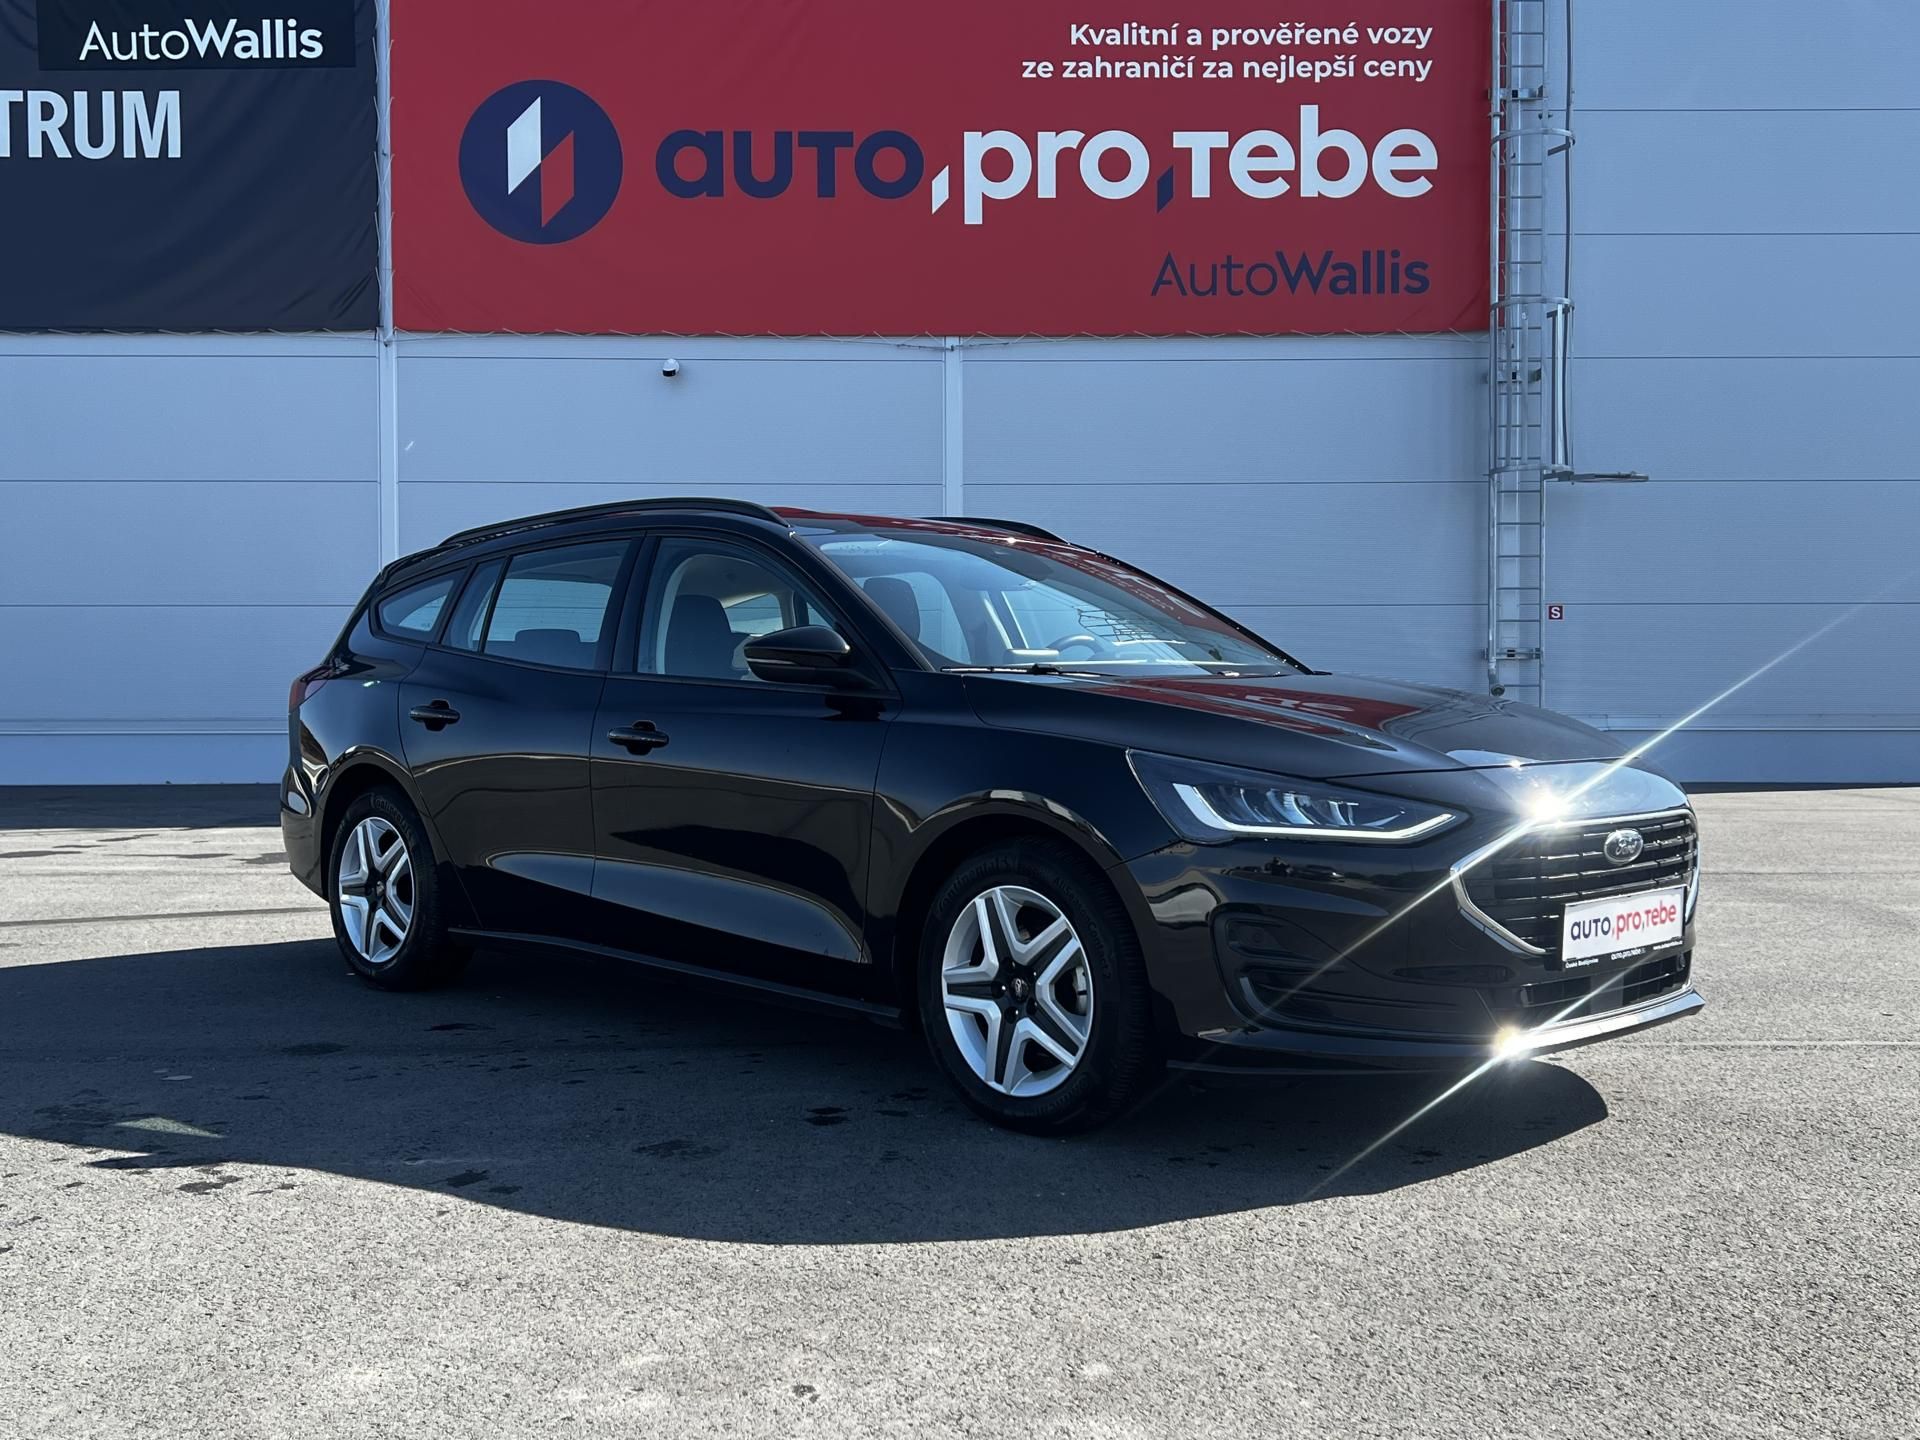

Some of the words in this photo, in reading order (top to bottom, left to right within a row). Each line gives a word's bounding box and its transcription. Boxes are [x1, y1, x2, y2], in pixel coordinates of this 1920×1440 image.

[78, 18, 324, 61] AutoWallis
[1070, 22, 1180, 46] Kvalitní
[1186, 29, 1202, 46] a
[1211, 22, 1359, 50] prověřené
[1366, 28, 1433, 49] vozy
[1021, 61, 1054, 79] ze
[1062, 54, 1196, 79] zahraničí
[1202, 61, 1234, 79] za
[1243, 54, 1358, 83] nejlepší
[1363, 57, 1433, 82] ceny
[1151, 249, 1431, 297] AutoWallis
[1551, 606, 1561, 619] S
